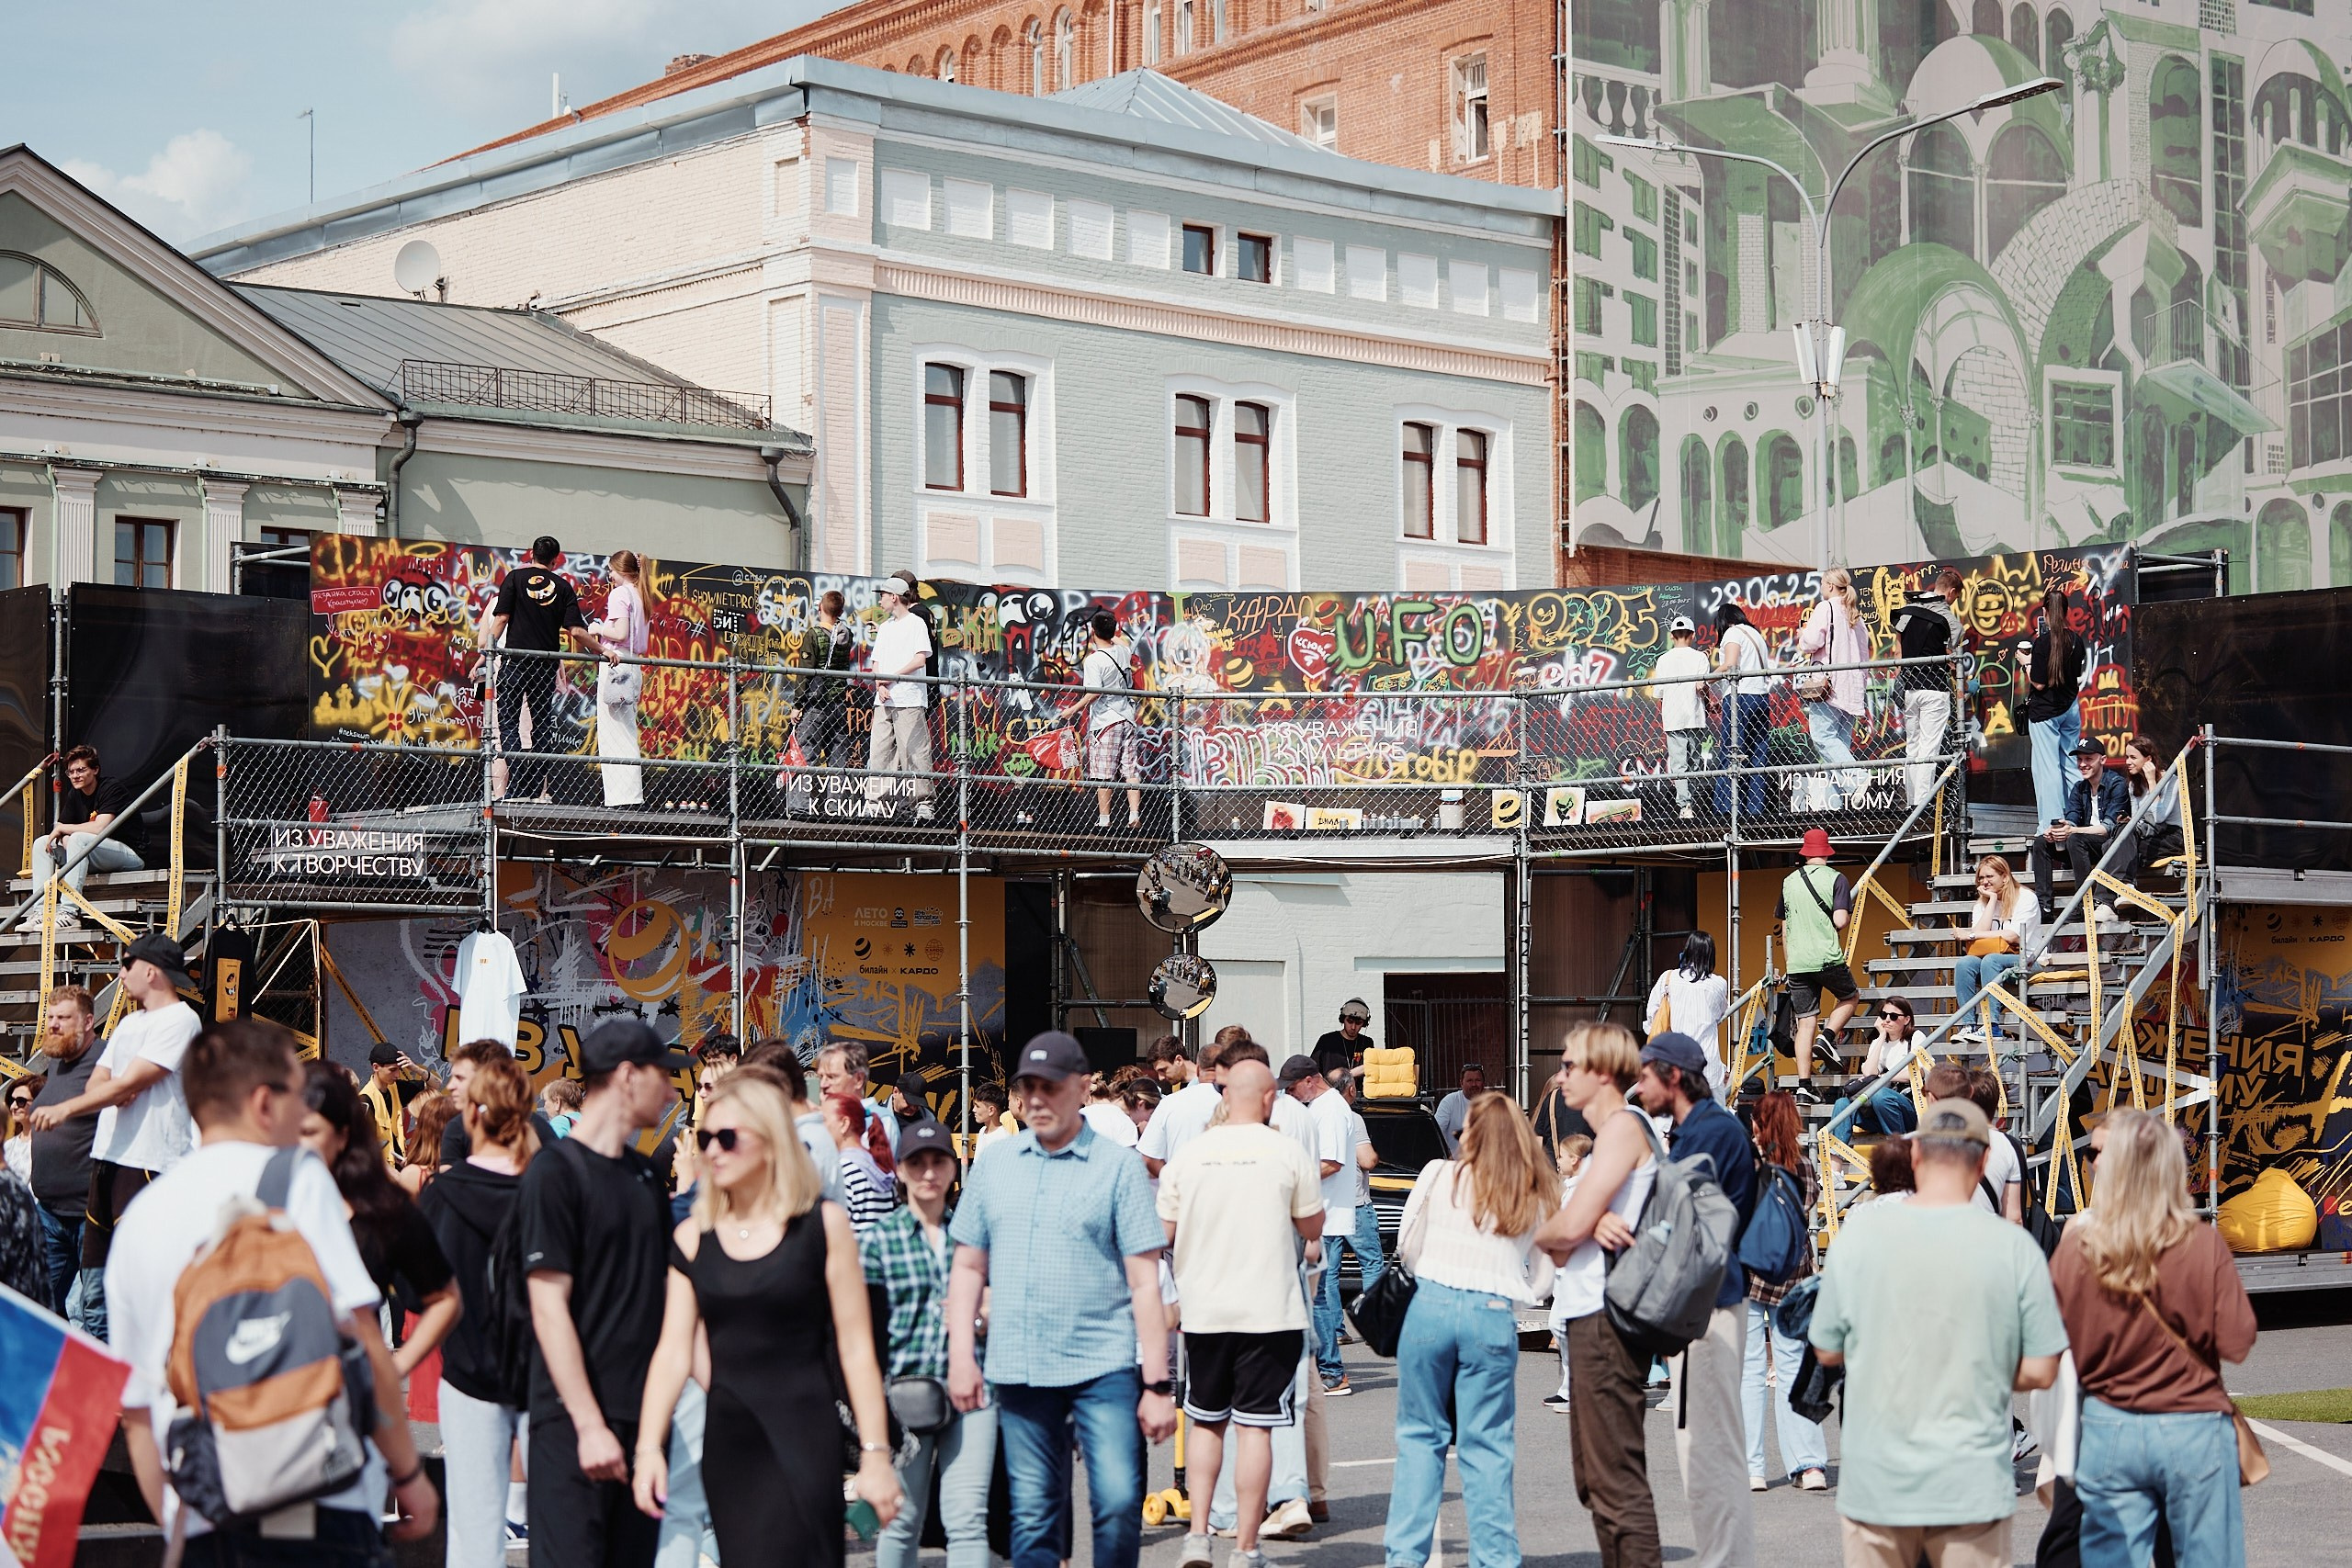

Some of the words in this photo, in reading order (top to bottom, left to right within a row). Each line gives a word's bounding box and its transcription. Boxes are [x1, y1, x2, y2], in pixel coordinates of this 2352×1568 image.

[1327, 601, 1484, 675] UFO
[1263, 721, 1291, 739] ИЗ
[1296, 721, 1419, 739] УВАЖЕНИЯ
[1276, 743, 1289, 760] К
[1296, 742, 1405, 760] КУЛЬТУРЕ
[788, 773, 815, 794] ИЗ
[818, 774, 917, 796] УВАЖЕНИЯ
[1780, 773, 1803, 791] ИЗ
[1805, 767, 1906, 789] УВАЖЕНИЯ
[808, 797, 820, 815] К
[824, 798, 899, 818] СКИЛЛУ
[1790, 795, 1801, 813] К
[1806, 791, 1895, 812] КАСТОМУ
[275, 828, 303, 848] ИЗ
[308, 829, 424, 852] УВАЖЕНИЯ
[273, 854, 287, 874] К
[293, 854, 425, 877] ТВОРЧЕСТВУ
[854, 907, 888, 919] ЛЕТО
[2309, 935, 2346, 943] КАРДО
[860, 964, 888, 976] билайн
